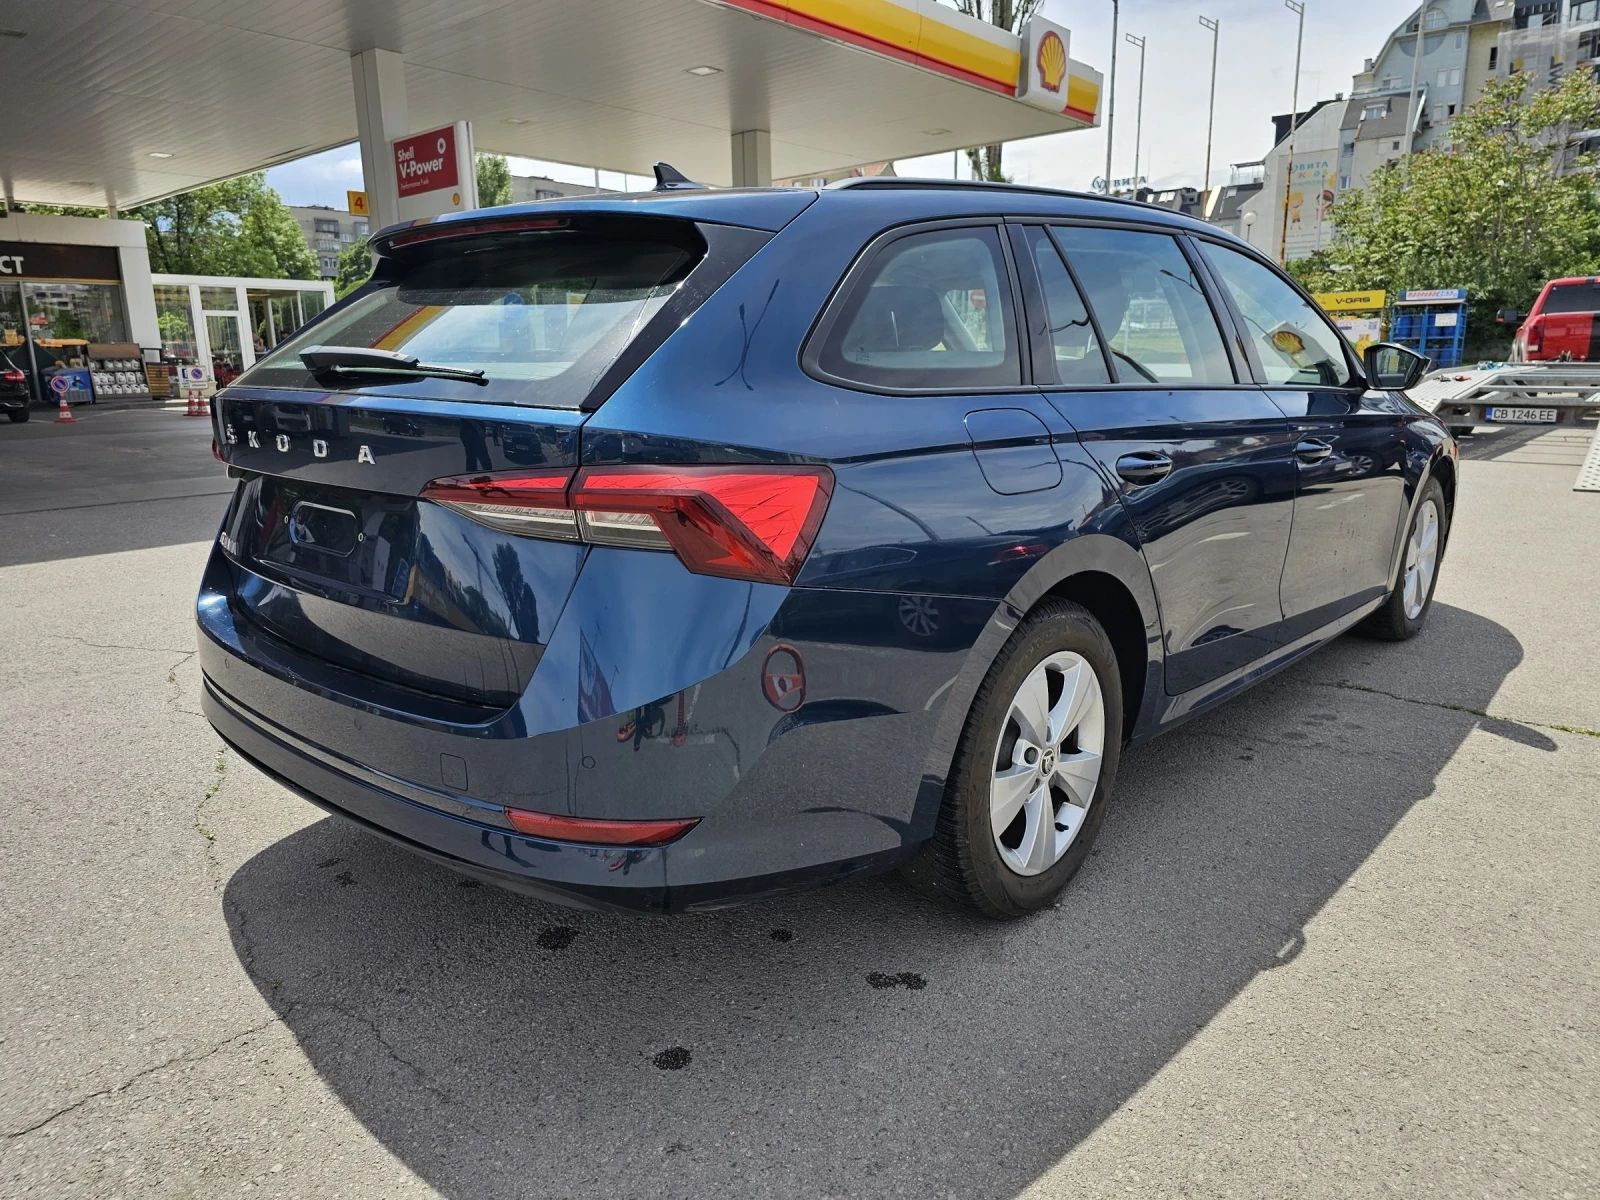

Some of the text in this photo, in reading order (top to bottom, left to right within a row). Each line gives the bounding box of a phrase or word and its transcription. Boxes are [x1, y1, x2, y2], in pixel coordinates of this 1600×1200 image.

[398, 146, 414, 162] Shell
[399, 158, 443, 179] V-Power
[354, 196, 365, 210] 4
[1335, 296, 1371, 305] V-GAS
[1493, 408, 1555, 421] CB 1246 EE
